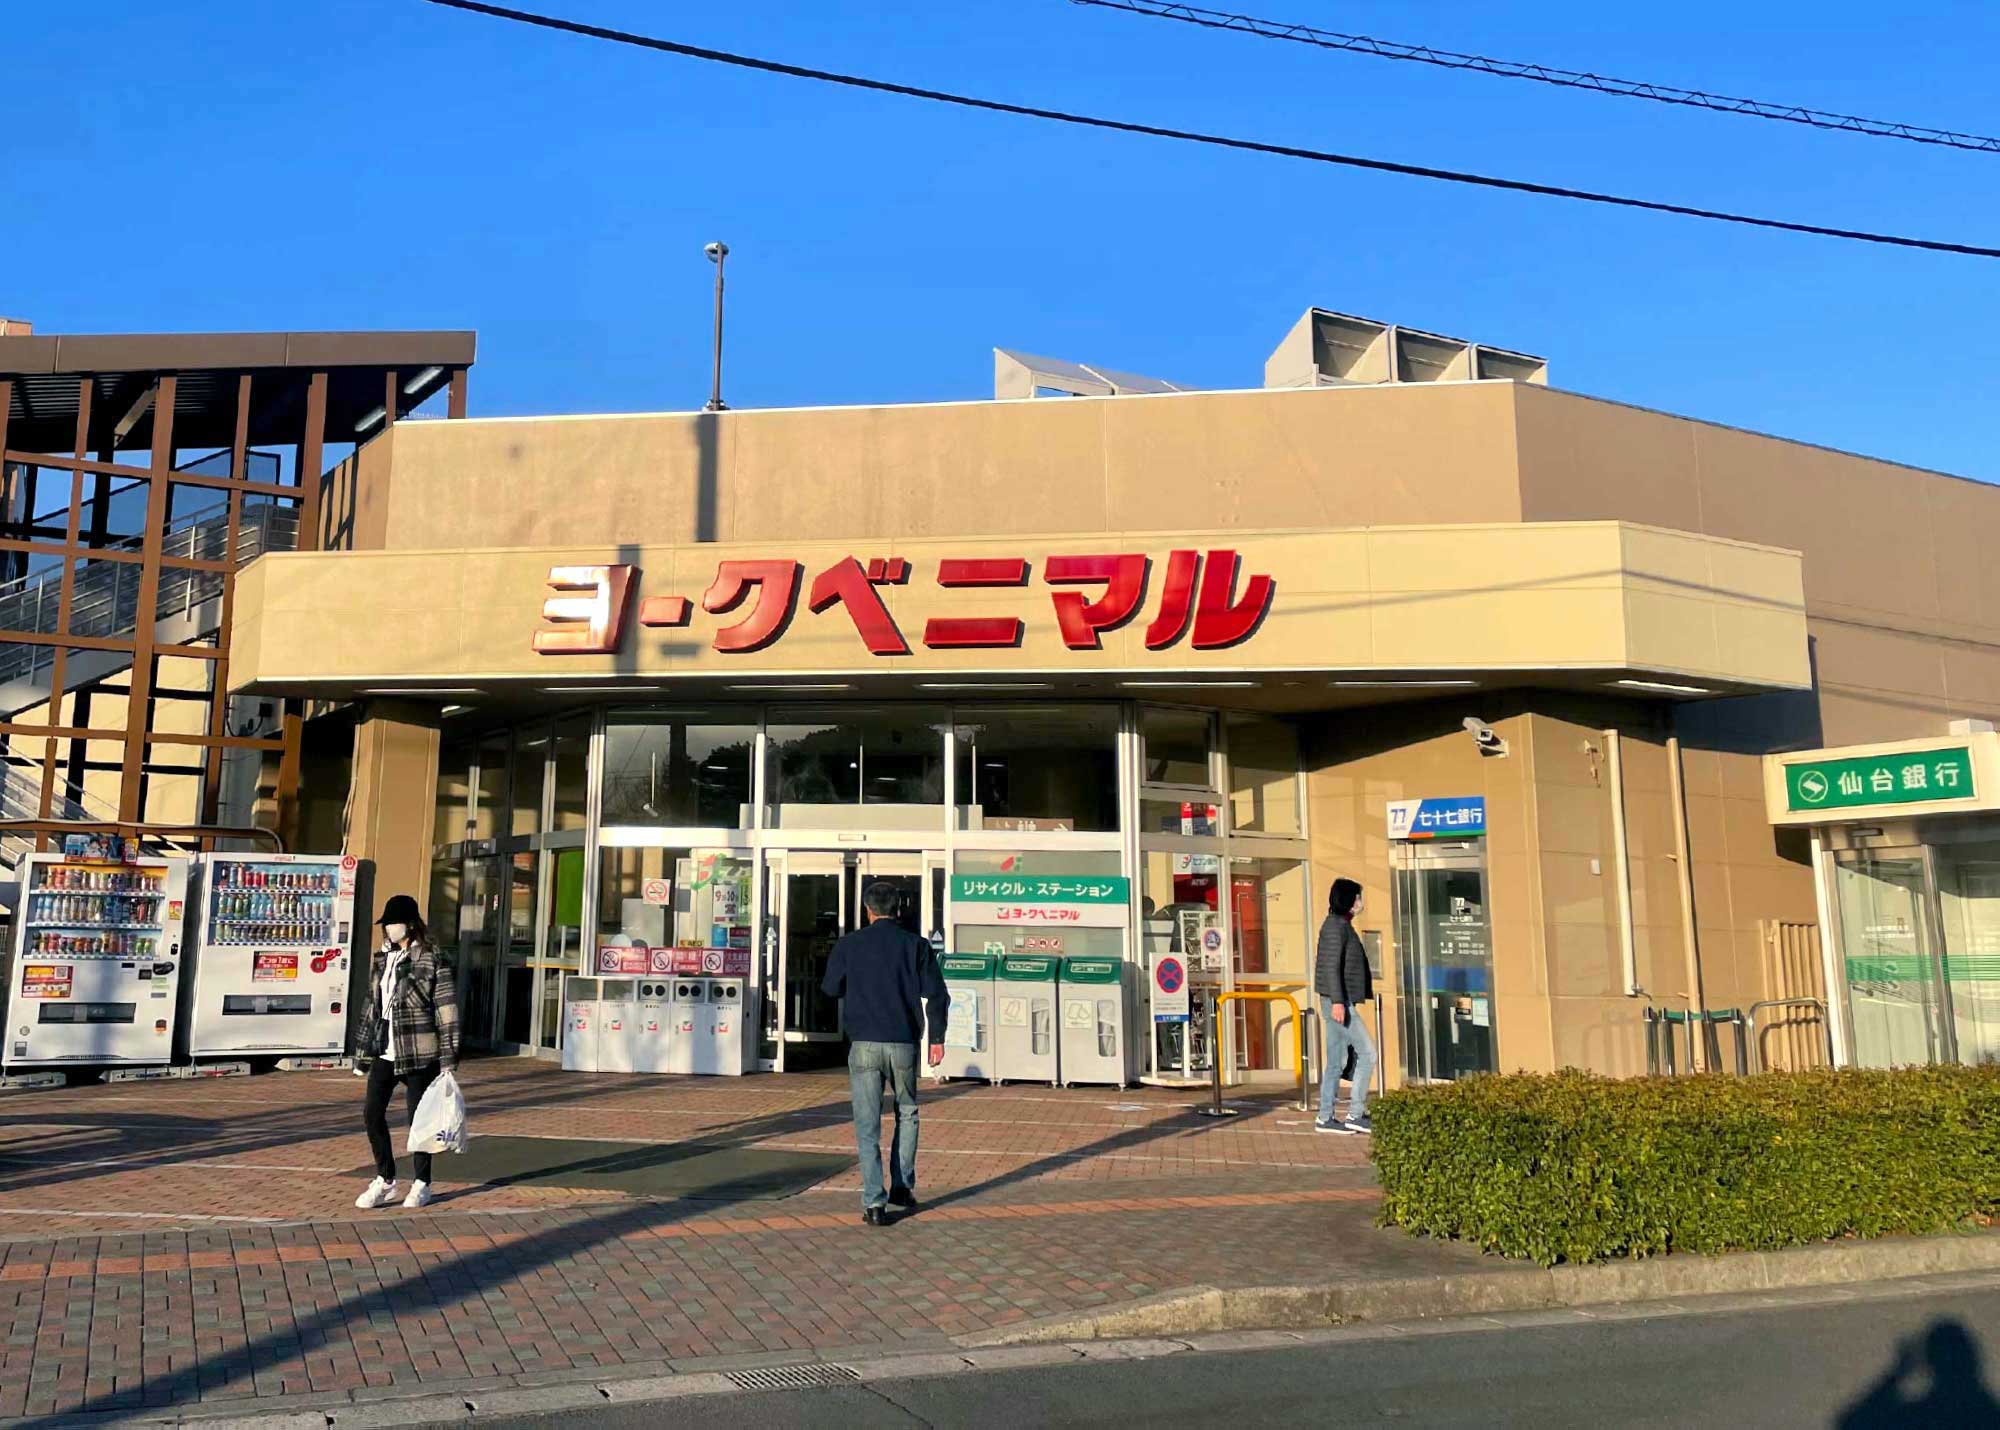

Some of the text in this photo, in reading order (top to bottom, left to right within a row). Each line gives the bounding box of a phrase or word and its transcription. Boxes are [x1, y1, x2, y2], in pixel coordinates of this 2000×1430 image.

[532, 549, 1271, 655] ヨークベニマル
[1837, 762, 1961, 796] 仙台銀行
[1390, 808, 1483, 827] 77 七十七銀行
[963, 880, 1114, 897] リサイクル・ステーション
